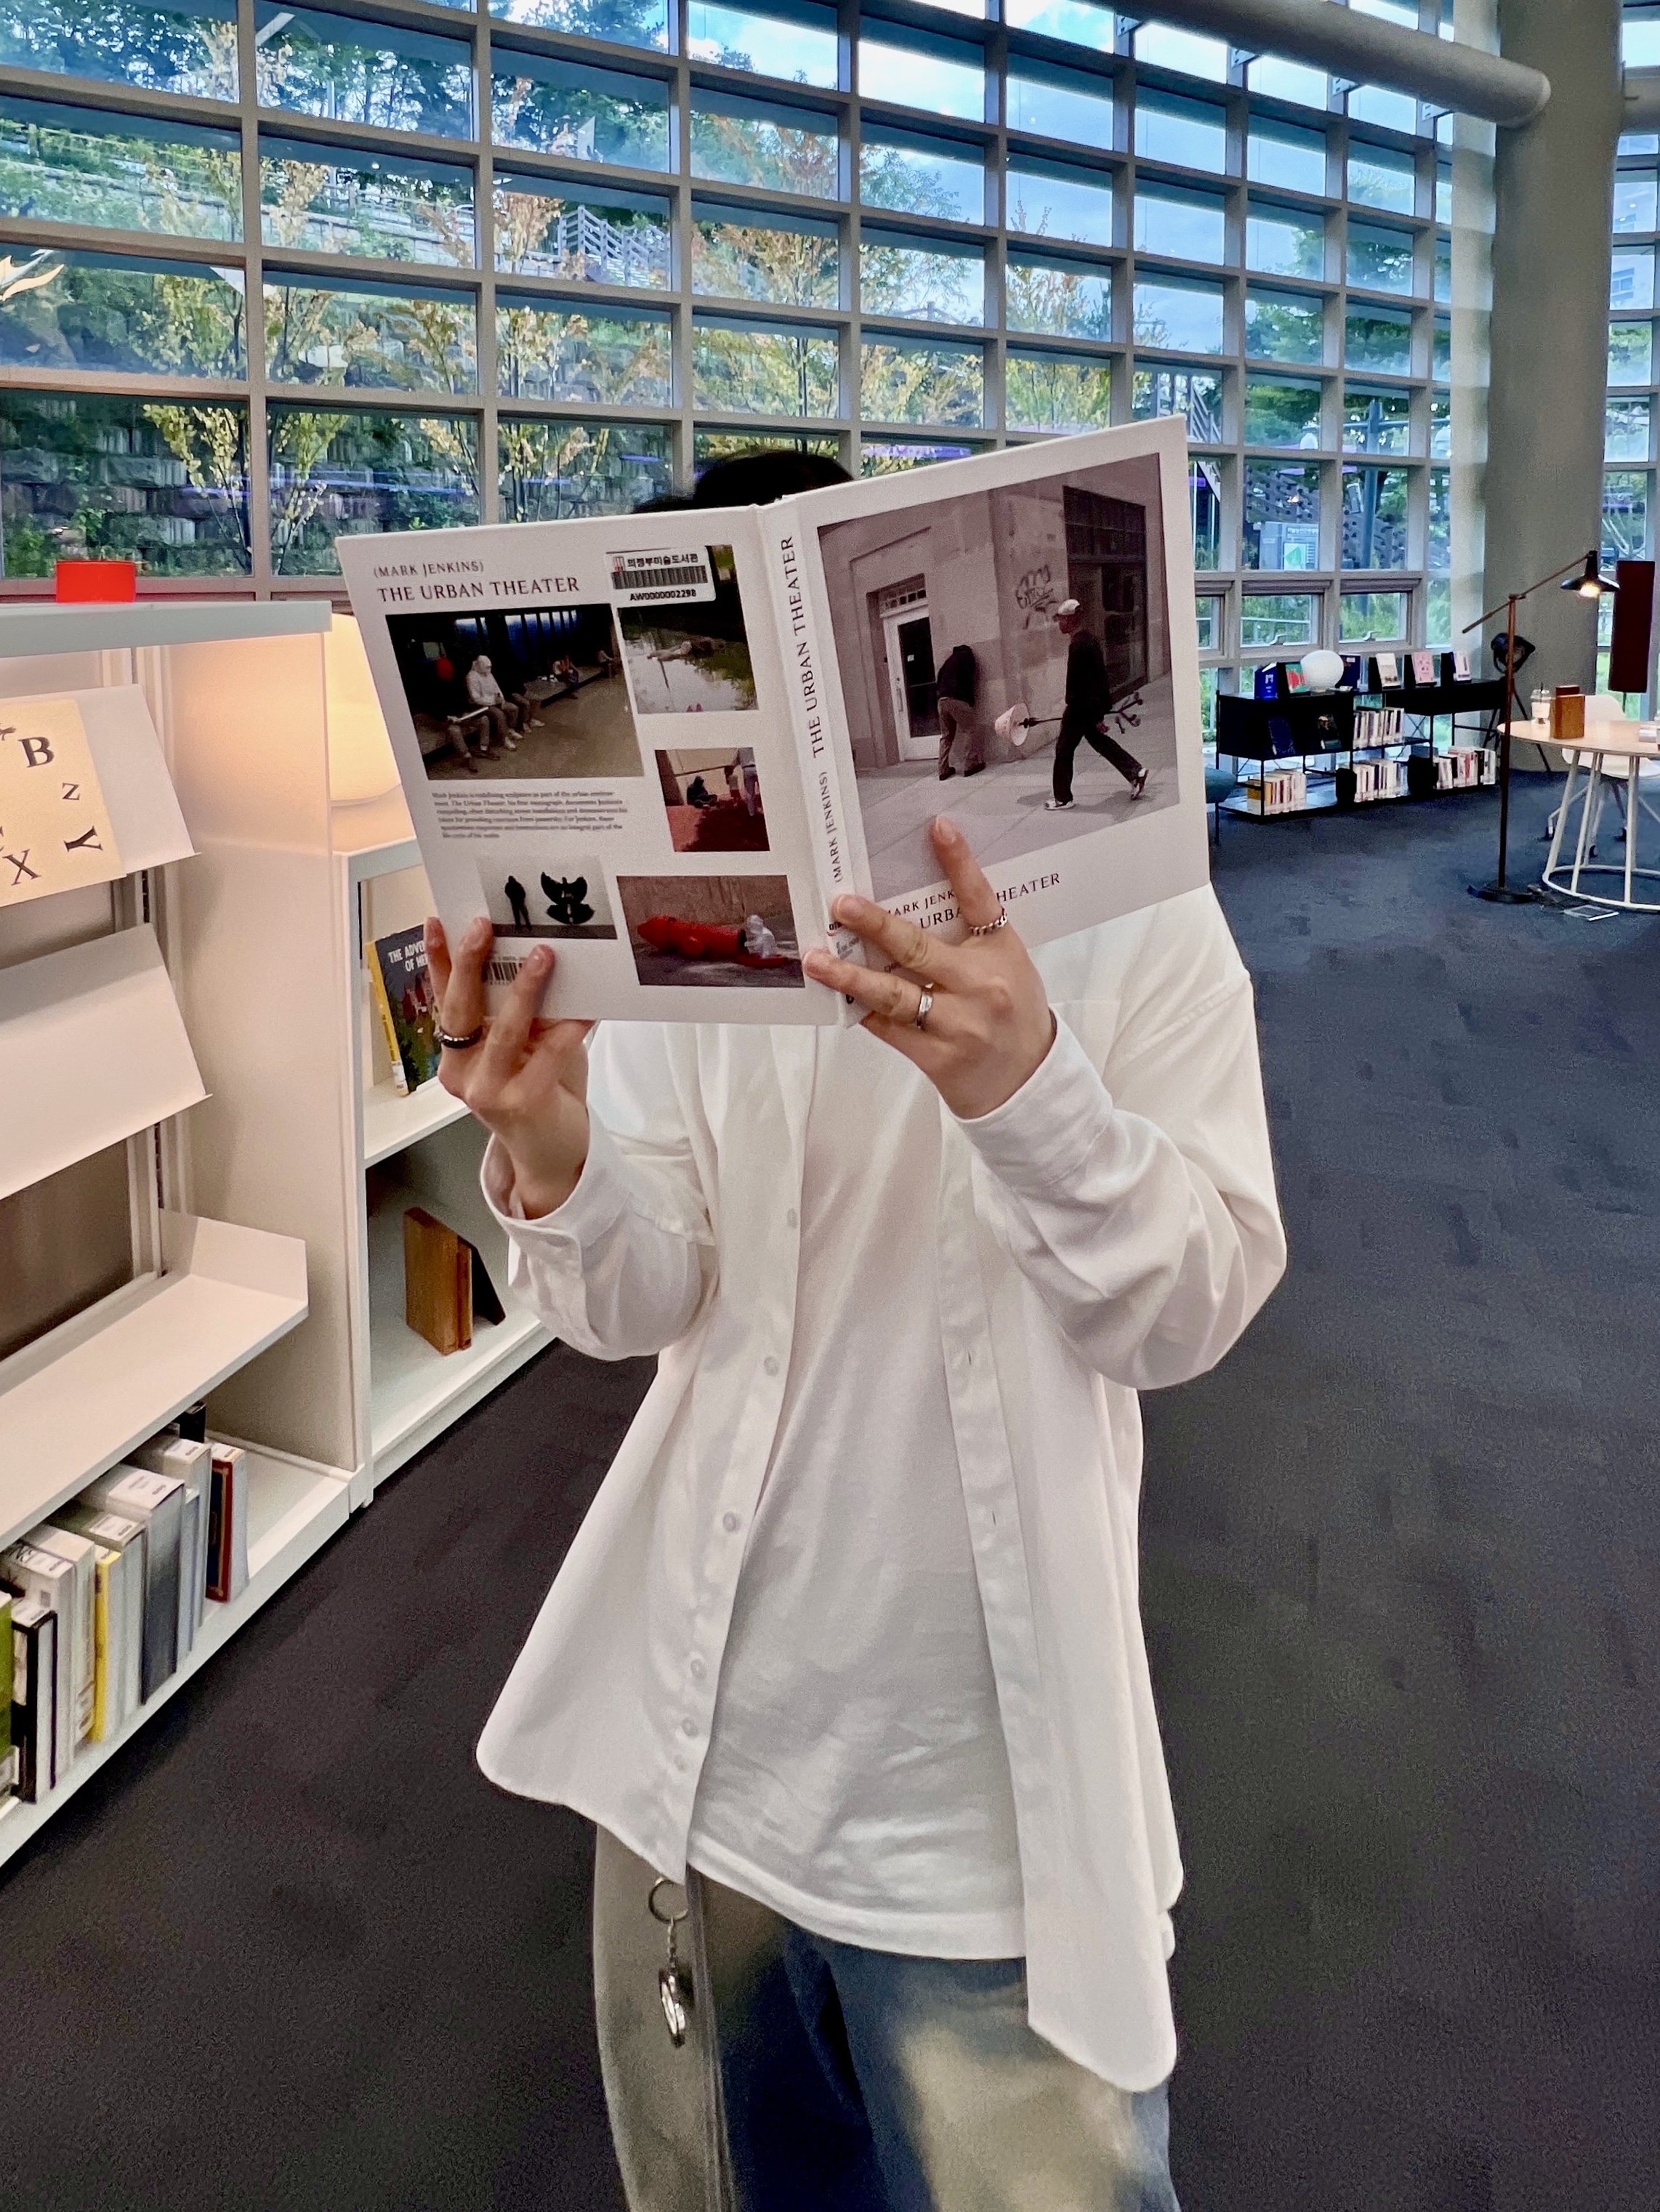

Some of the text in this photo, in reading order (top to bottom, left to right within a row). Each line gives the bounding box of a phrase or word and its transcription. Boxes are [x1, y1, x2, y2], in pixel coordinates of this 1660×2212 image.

[373, 561, 484, 578] (MARK JENKINS)
[377, 577, 580, 602] THE URBAN THEATER
[781, 536, 824, 759] THE URBAN THEATER
[17, 736, 55, 768] B
[63, 826, 103, 852] Y
[818, 771, 844, 883] (MARK JENKINS)
[2, 849, 41, 886] X
[888, 889, 955, 916] ARK JENK
[919, 873, 1060, 929] URB HEATER
[387, 948, 403, 964] THE
[405, 958, 414, 972] OF
